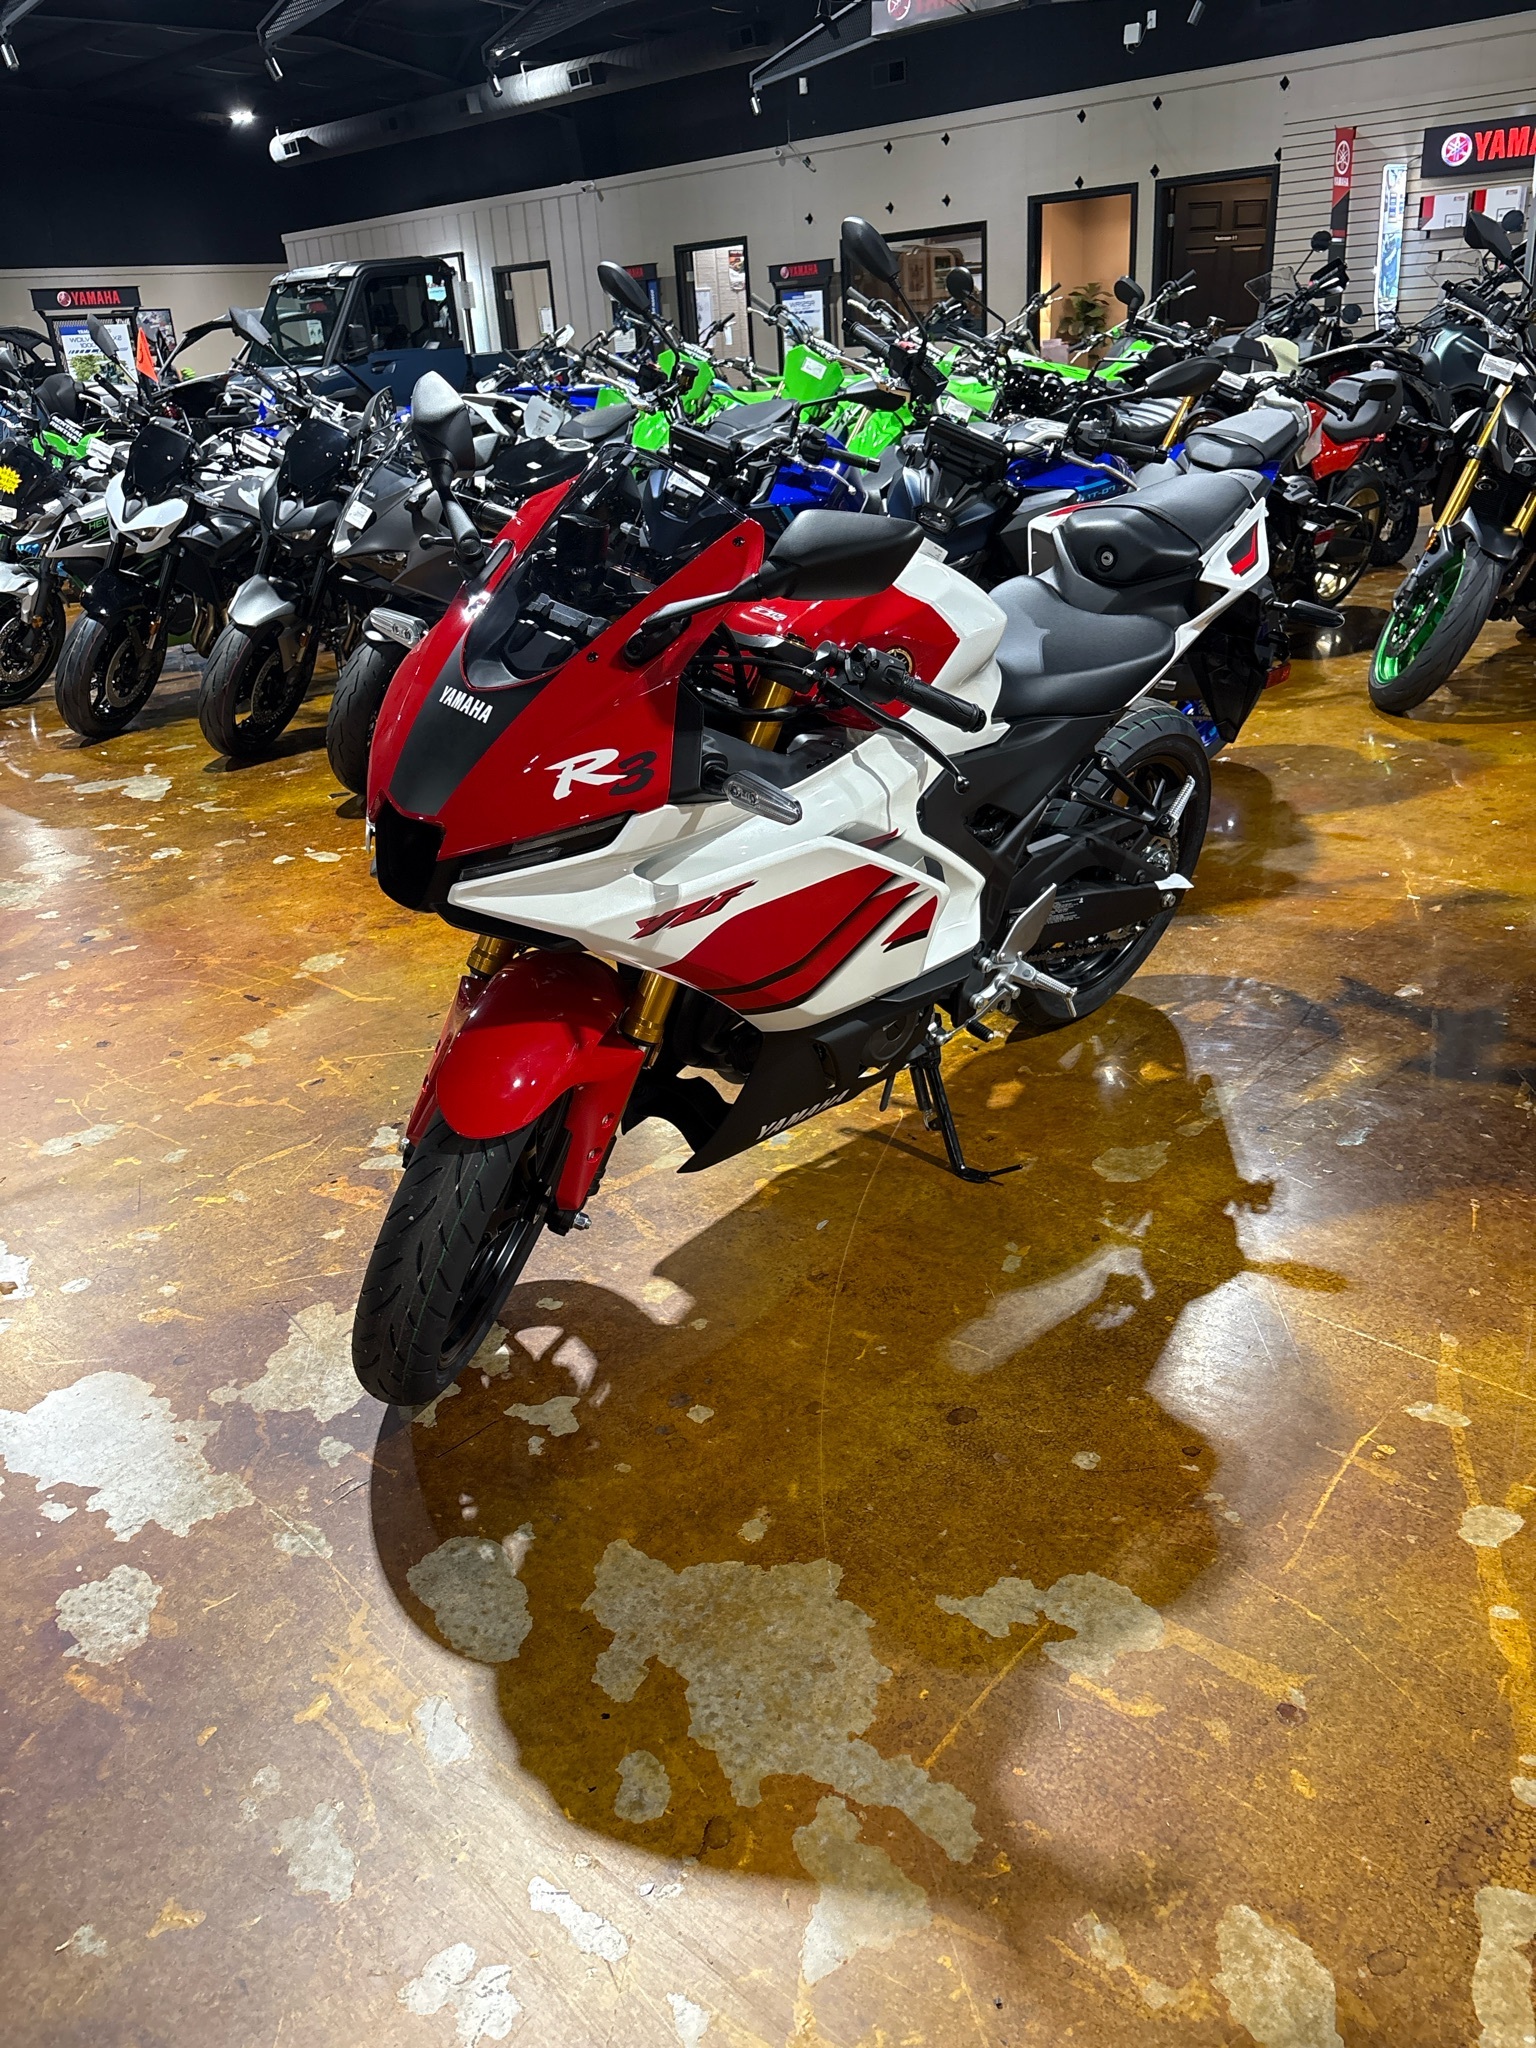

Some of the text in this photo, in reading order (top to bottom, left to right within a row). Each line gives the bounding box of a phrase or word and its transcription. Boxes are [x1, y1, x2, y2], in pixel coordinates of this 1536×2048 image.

[788, 263, 818, 278] YAMAHA
[71, 290, 121, 305] YAMAHA
[439, 685, 493, 724] YAMAHA
[543, 748, 657, 801] R3
[756, 1088, 850, 1140] YAMAHA
